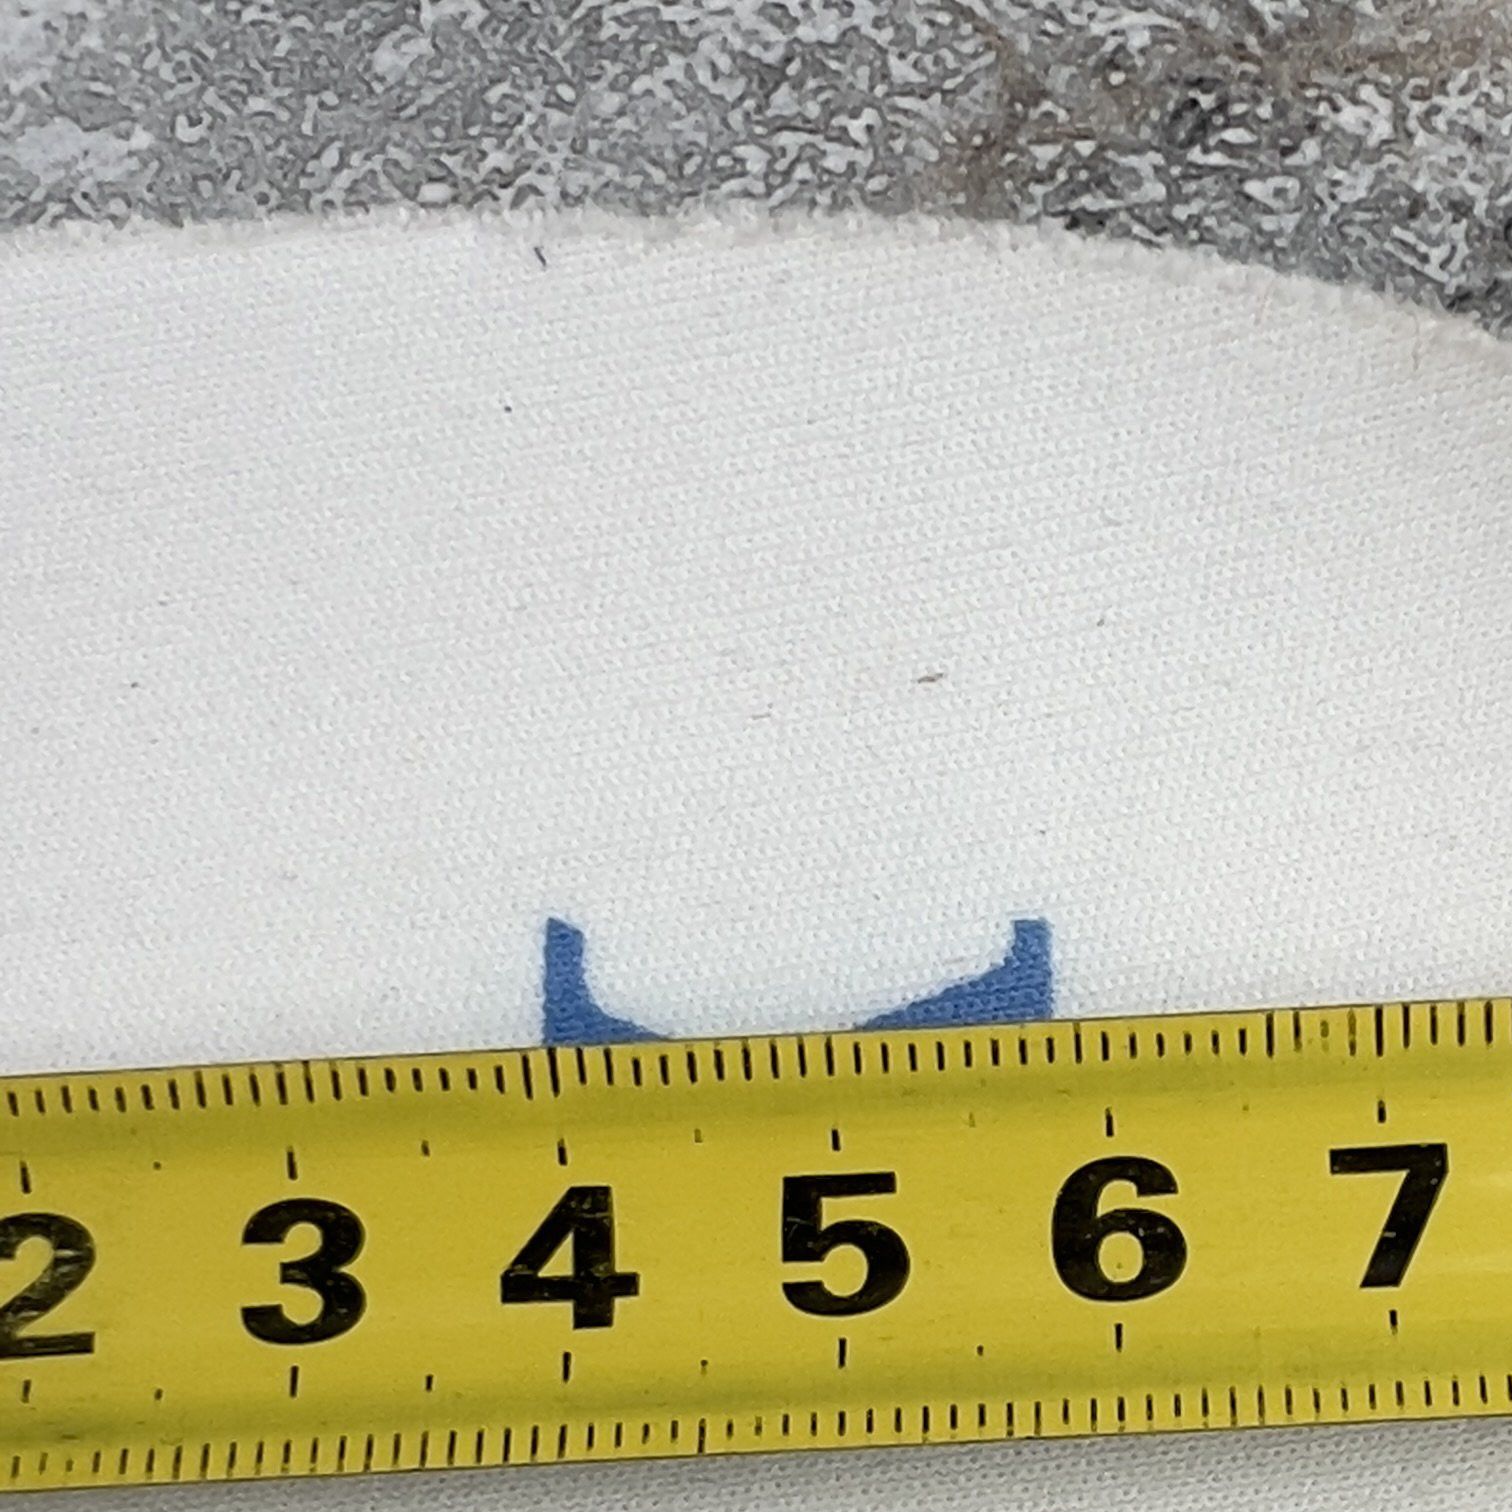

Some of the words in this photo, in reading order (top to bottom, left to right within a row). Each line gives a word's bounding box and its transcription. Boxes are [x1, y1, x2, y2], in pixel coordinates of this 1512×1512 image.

[0, 1212, 97, 1359] 2
[241, 1198, 367, 1345] 3
[500, 1185, 640, 1330] 4
[781, 1171, 912, 1317] 5
[1051, 1156, 1188, 1302] 6
[1329, 1143, 1449, 1289] 7
